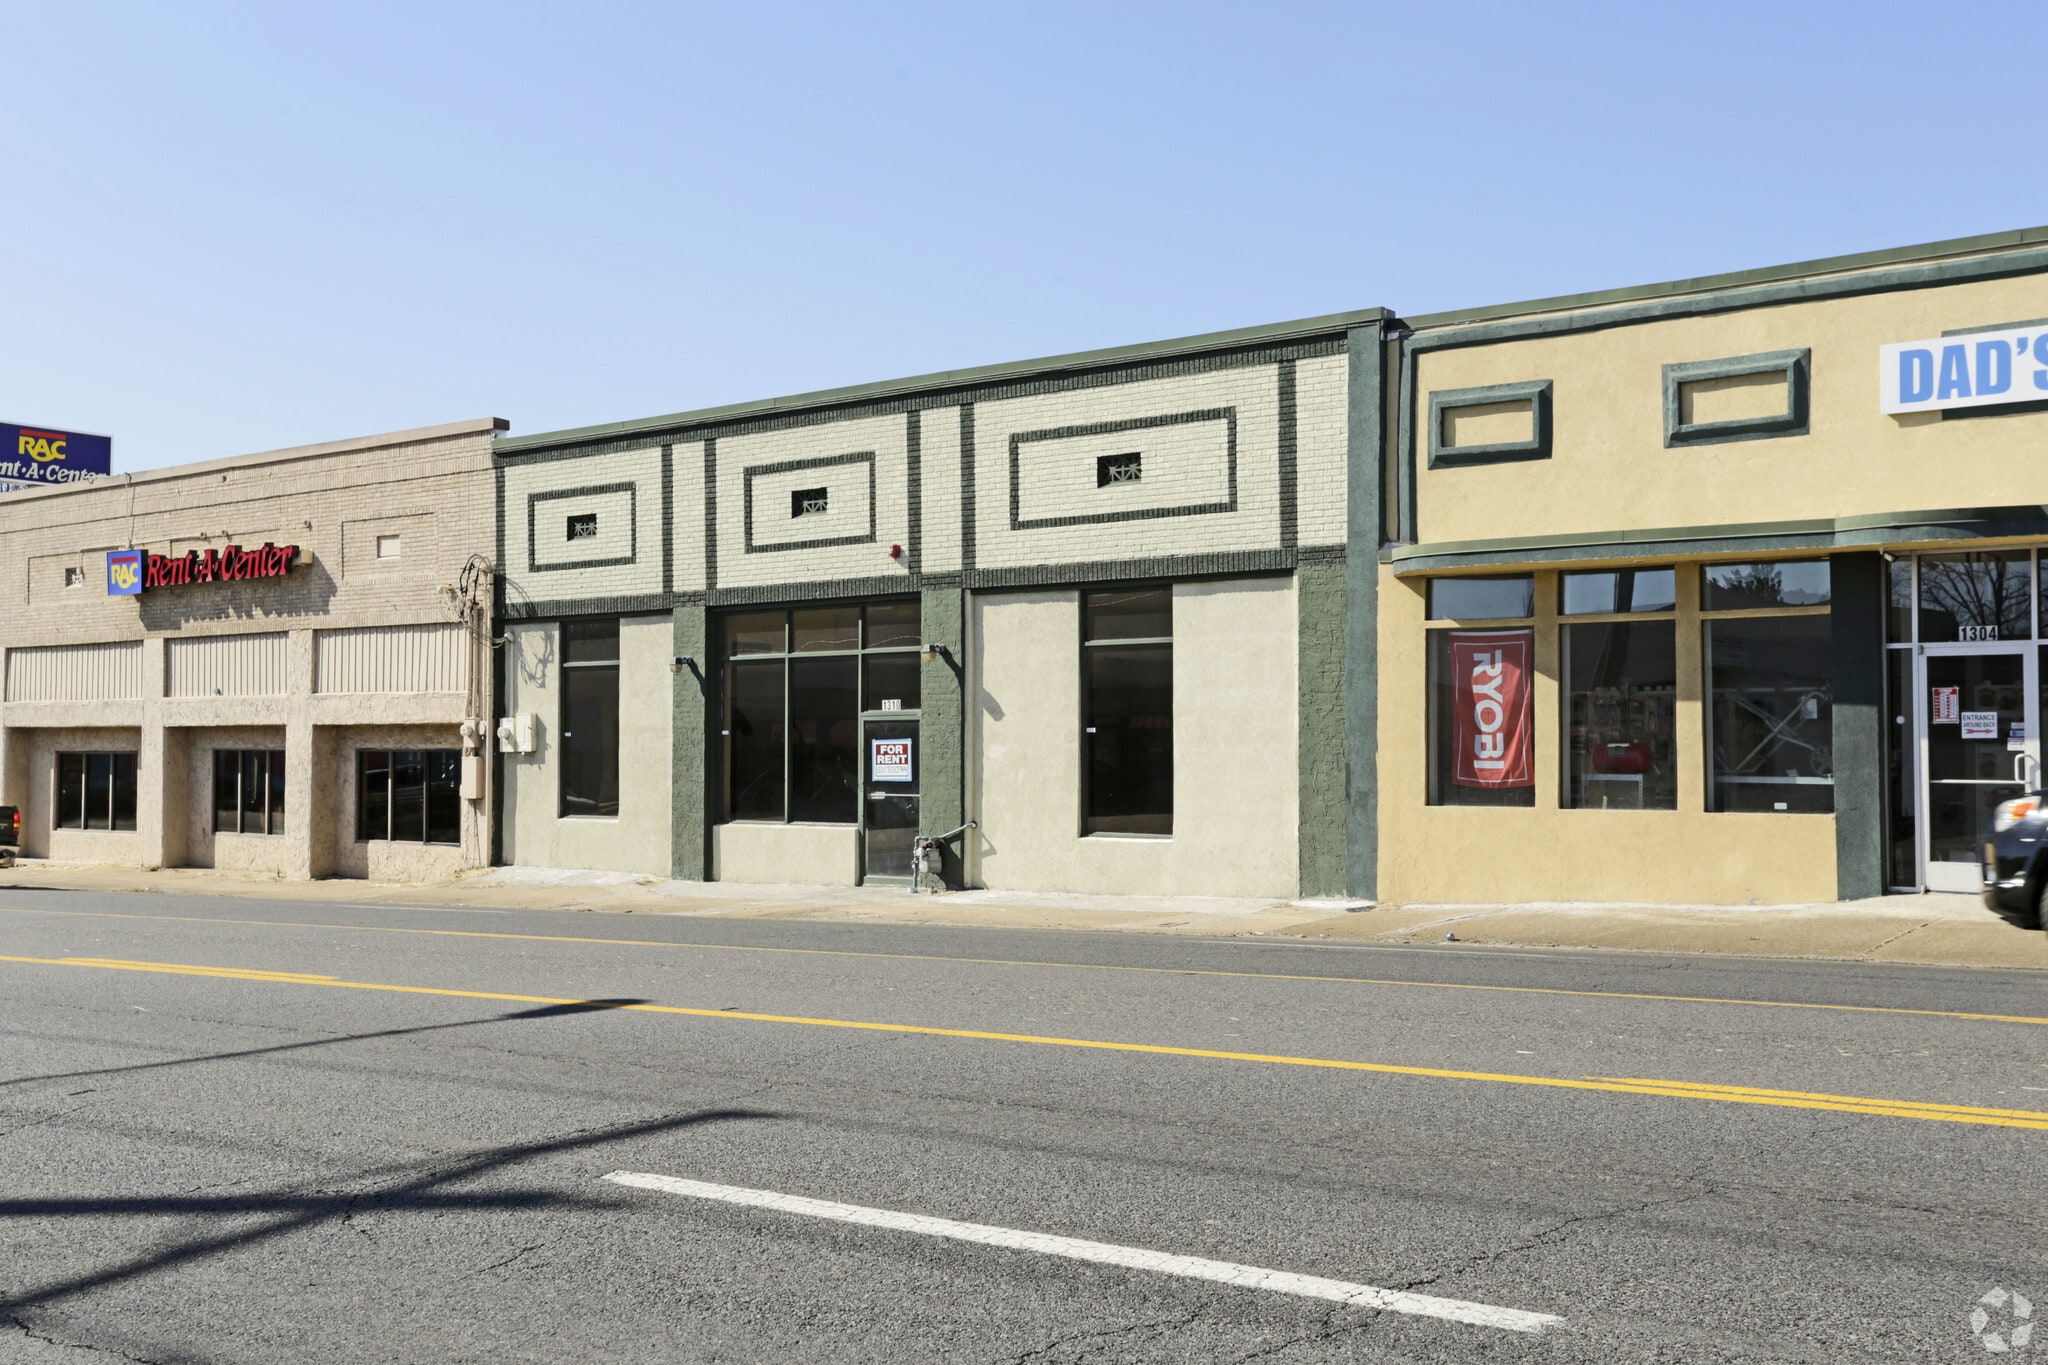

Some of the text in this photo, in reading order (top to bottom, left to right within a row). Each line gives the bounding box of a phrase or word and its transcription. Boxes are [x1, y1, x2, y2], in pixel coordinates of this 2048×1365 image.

[18, 435, 67, 462] RAC
[111, 562, 139, 589] RAC
[1961, 626, 1997, 641] 1304
[883, 701, 901, 711] 1310
[1472, 649, 1505, 769] RYOBI
[1962, 714, 1996, 722] ENTRANCE
[880, 744, 903, 755] FOR
[876, 755, 907, 764] RENT
